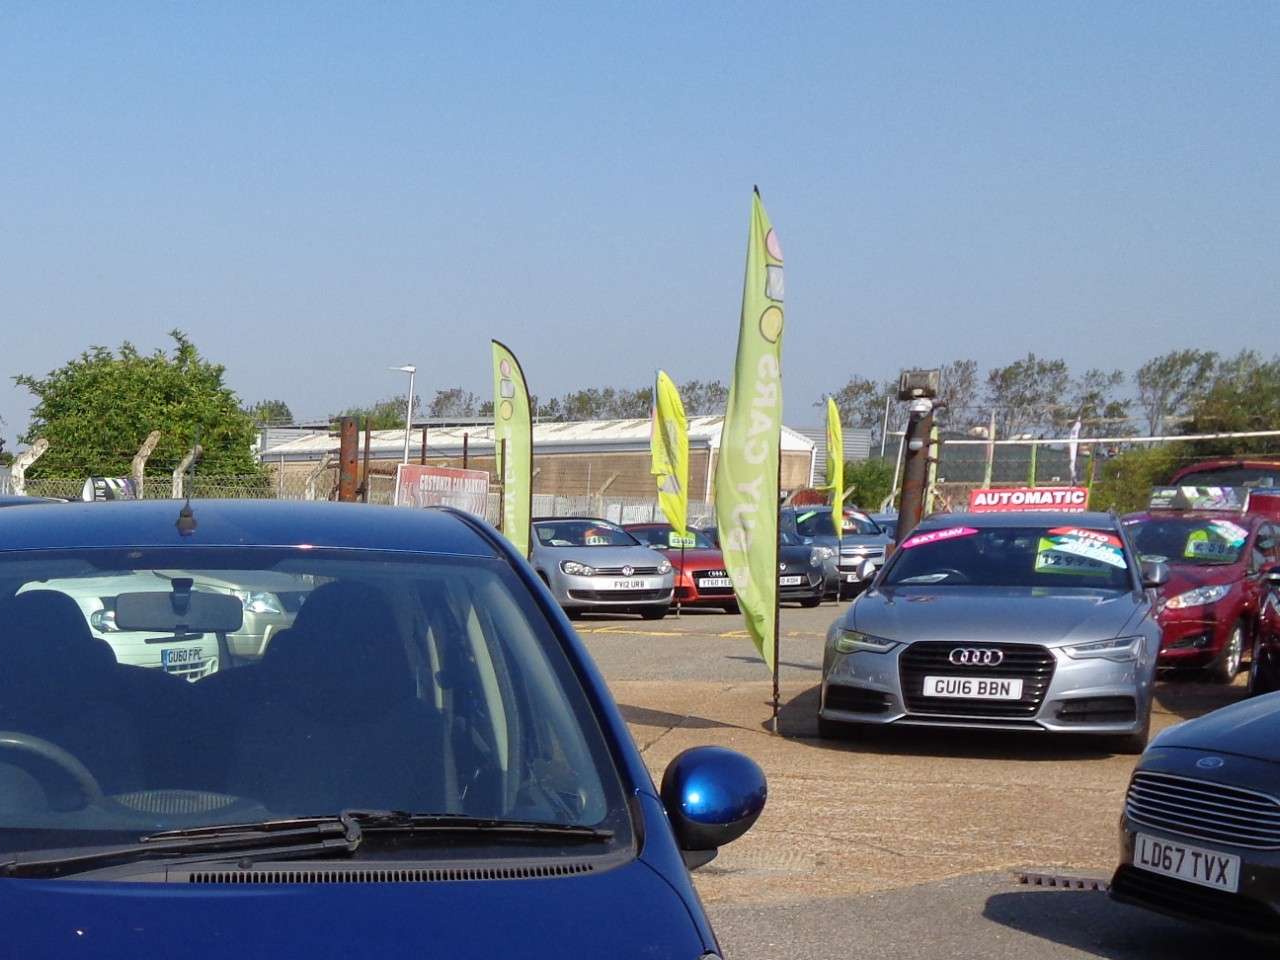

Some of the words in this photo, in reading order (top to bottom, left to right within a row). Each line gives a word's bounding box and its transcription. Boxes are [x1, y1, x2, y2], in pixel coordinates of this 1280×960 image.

[974, 490, 1085, 506] AUTOMATIC
[1069, 527, 1110, 542] AUTO
[934, 679, 972, 695] GU16
[977, 681, 1011, 697] BBN
[1140, 839, 1186, 874] LD67
[1191, 851, 1230, 885] TVX
